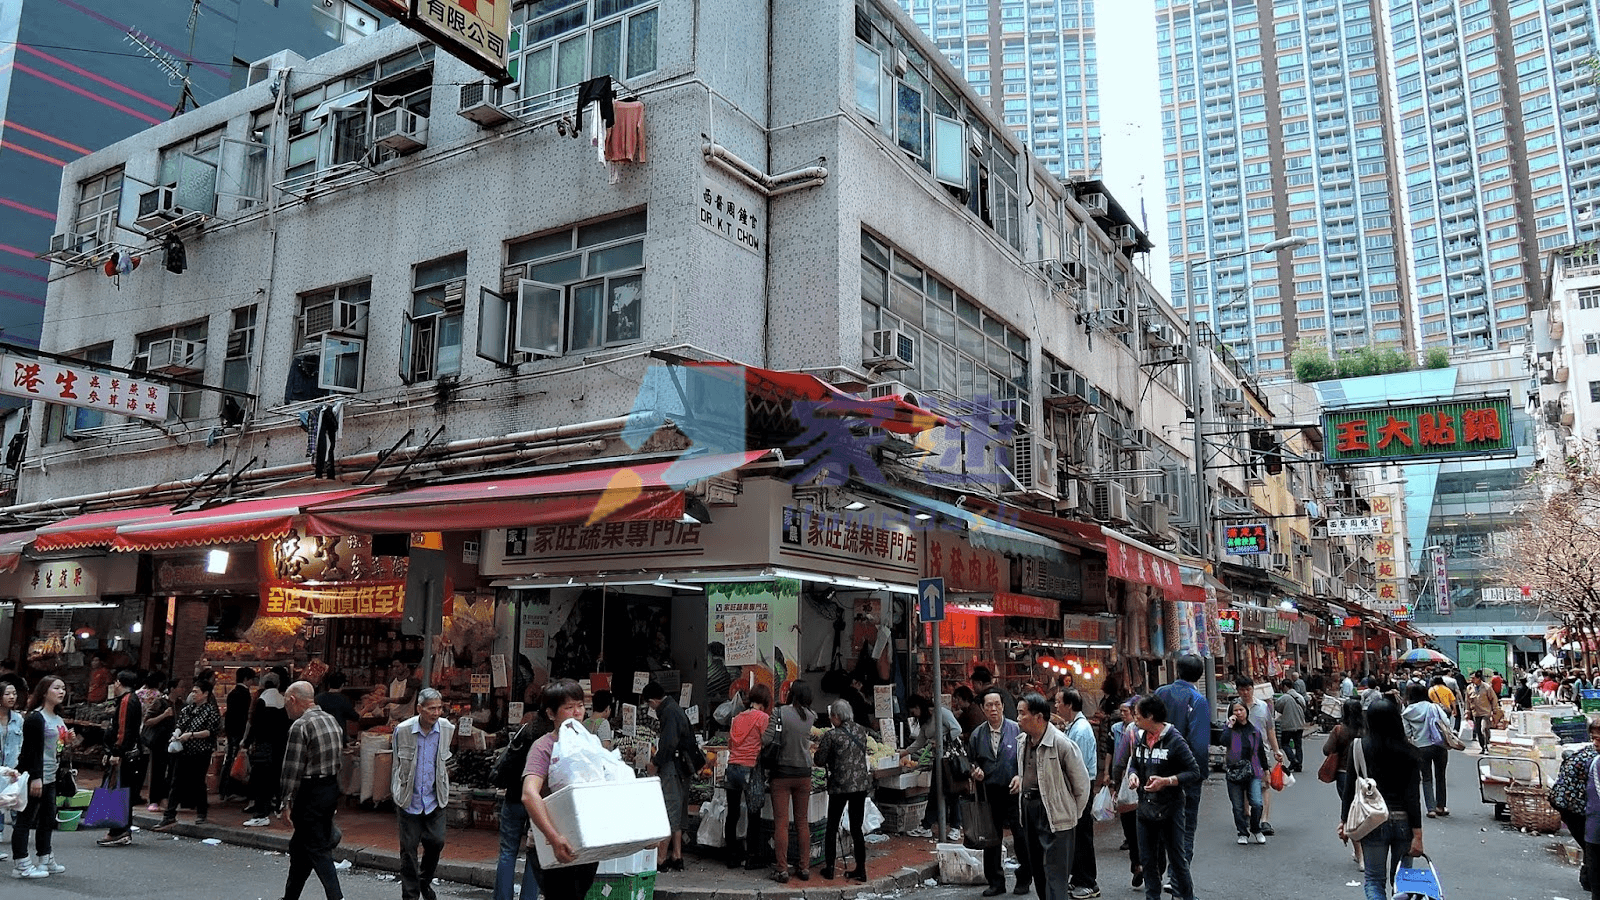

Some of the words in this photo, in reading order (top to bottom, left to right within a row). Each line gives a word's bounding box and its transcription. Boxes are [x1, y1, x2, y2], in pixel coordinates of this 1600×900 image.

[427, 0, 504, 59] 有限公司
[700, 207, 715, 227] DR.
[737, 228, 759, 251] CHOW
[13, 362, 79, 400] 港生
[88, 390, 157, 414] 參茸海味
[533, 519, 702, 553] 家旺蔬果專門店
[807, 513, 918, 564] 家旺蔬果專門店
